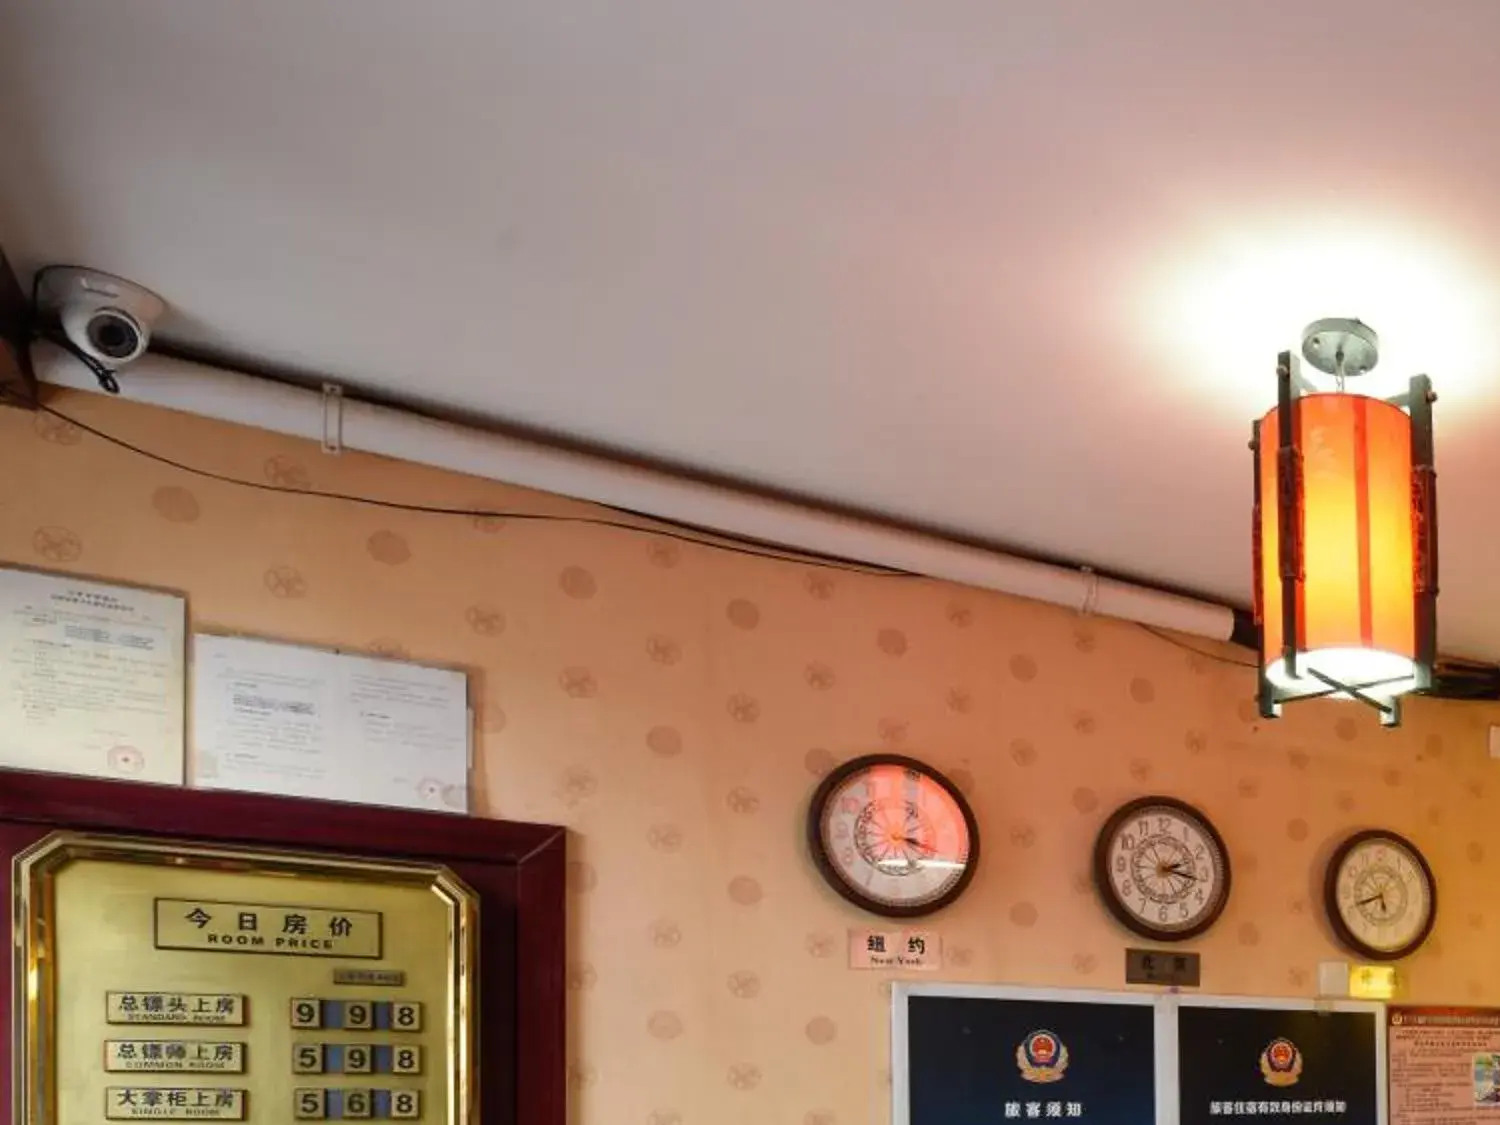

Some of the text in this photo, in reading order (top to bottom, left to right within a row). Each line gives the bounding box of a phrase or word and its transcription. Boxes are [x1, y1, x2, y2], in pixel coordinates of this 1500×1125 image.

[185, 907, 353, 936] 今日房价
[207, 933, 334, 949] ROOM PRICE
[867, 935, 925, 954] 纽约
[119, 994, 234, 1015] 总镖头上房
[296, 1003, 414, 1026] 998
[299, 1047, 414, 1069] 598
[117, 1088, 233, 1108] 大掌柜上房
[301, 1093, 413, 1114] 568
[1004, 1101, 1082, 1118] 旅客须知
